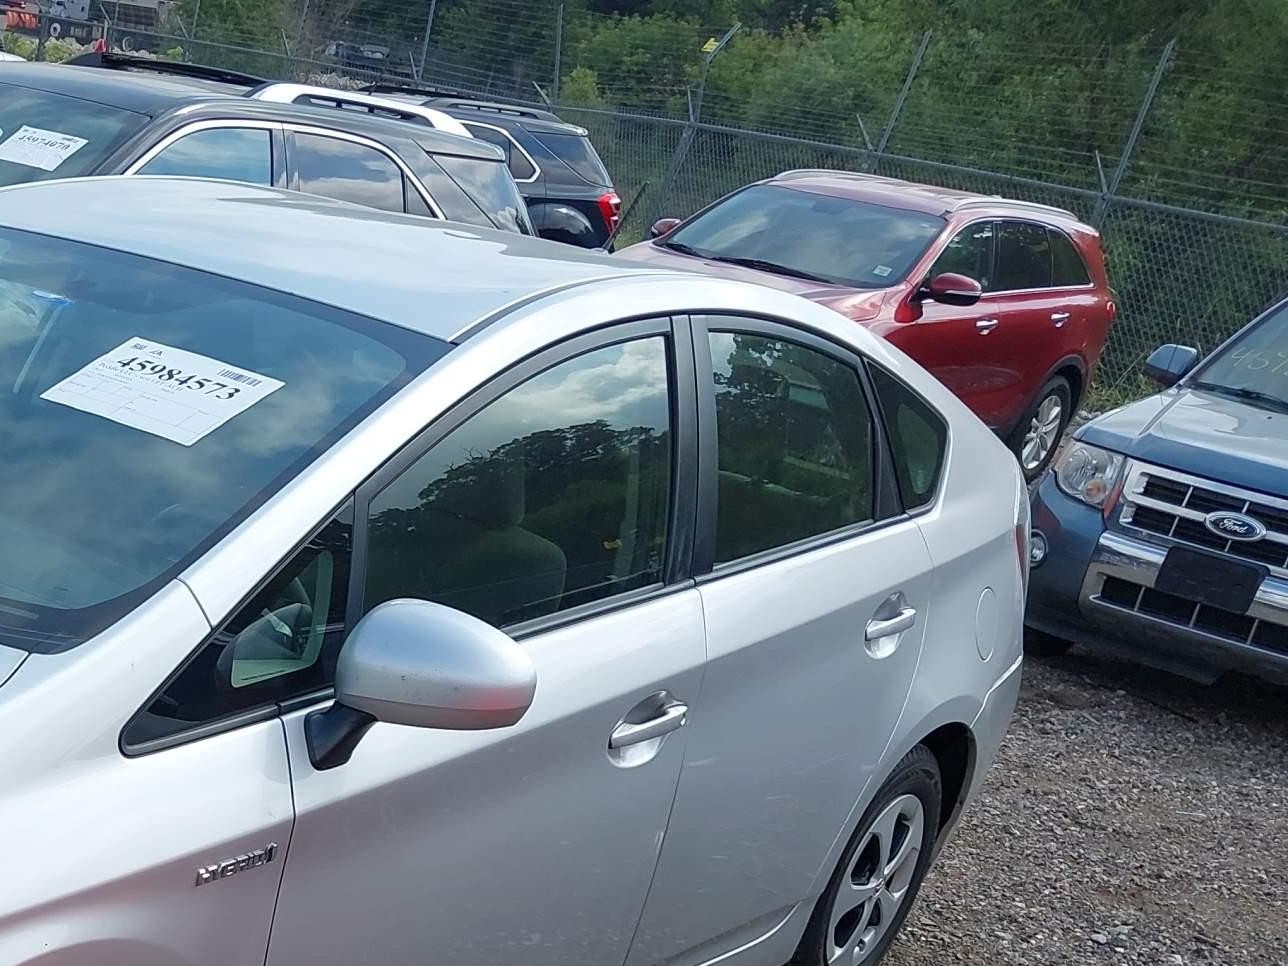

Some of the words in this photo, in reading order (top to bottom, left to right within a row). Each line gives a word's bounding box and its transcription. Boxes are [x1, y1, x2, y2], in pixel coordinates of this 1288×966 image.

[117, 357, 241, 400] 45984573
[1219, 518, 1249, 534] Ford
[195, 848, 267, 887] HYBRID
